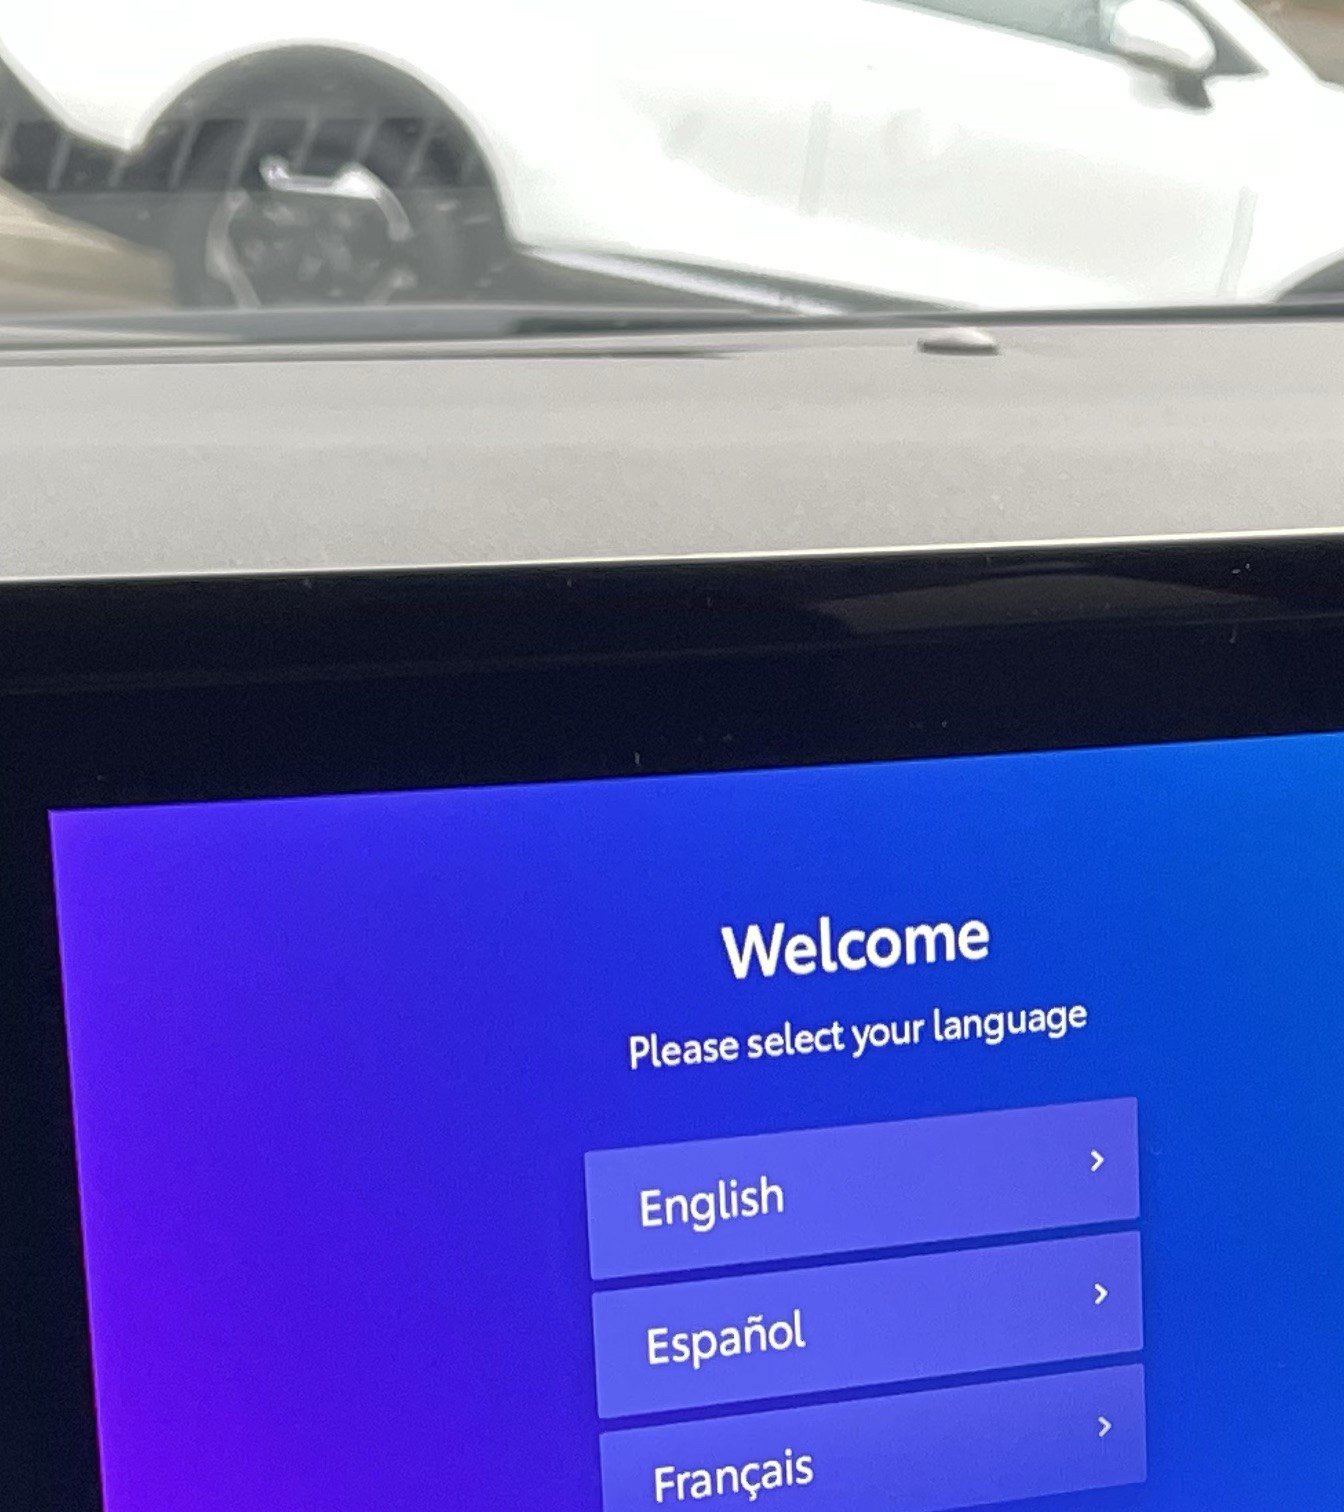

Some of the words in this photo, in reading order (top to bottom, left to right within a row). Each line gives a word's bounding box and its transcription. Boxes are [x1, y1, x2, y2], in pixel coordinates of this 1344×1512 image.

[720, 915, 991, 980] Welcome
[628, 1032, 740, 1071] Please
[746, 1020, 846, 1060] select
[850, 1018, 926, 1060] your
[932, 1004, 1089, 1046] language
[639, 1174, 785, 1233] English
[646, 1308, 807, 1371] Español
[653, 1447, 814, 1504] Français
